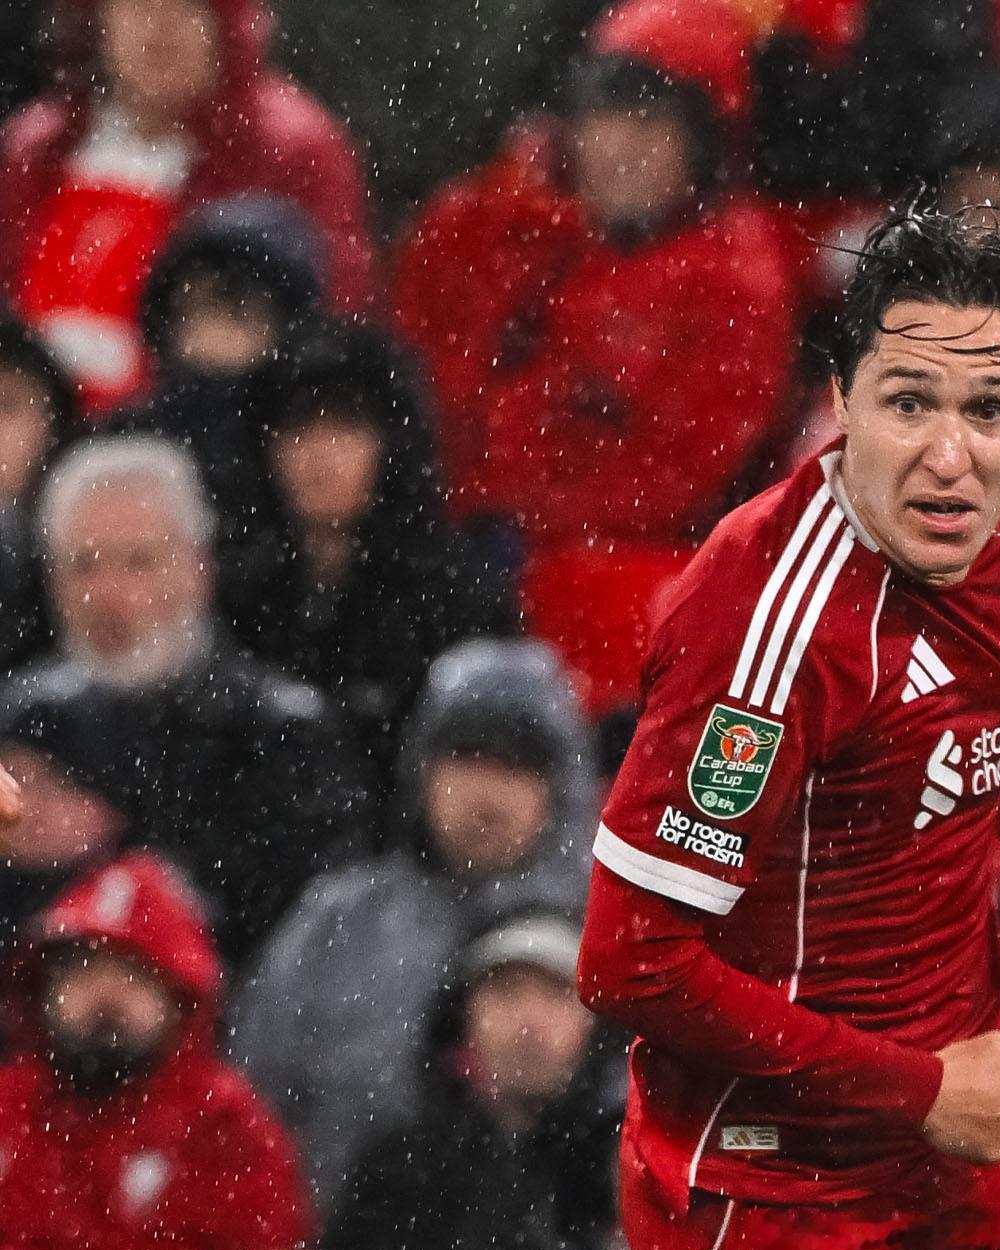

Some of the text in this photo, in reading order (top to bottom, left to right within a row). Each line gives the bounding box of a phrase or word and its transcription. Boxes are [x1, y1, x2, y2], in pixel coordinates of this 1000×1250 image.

[700, 755, 765, 774] Carabao
[711, 771, 743, 787] Cup
[717, 797, 735, 812] EFL
[661, 805, 742, 850] No room
[656, 822, 744, 868] for racism
